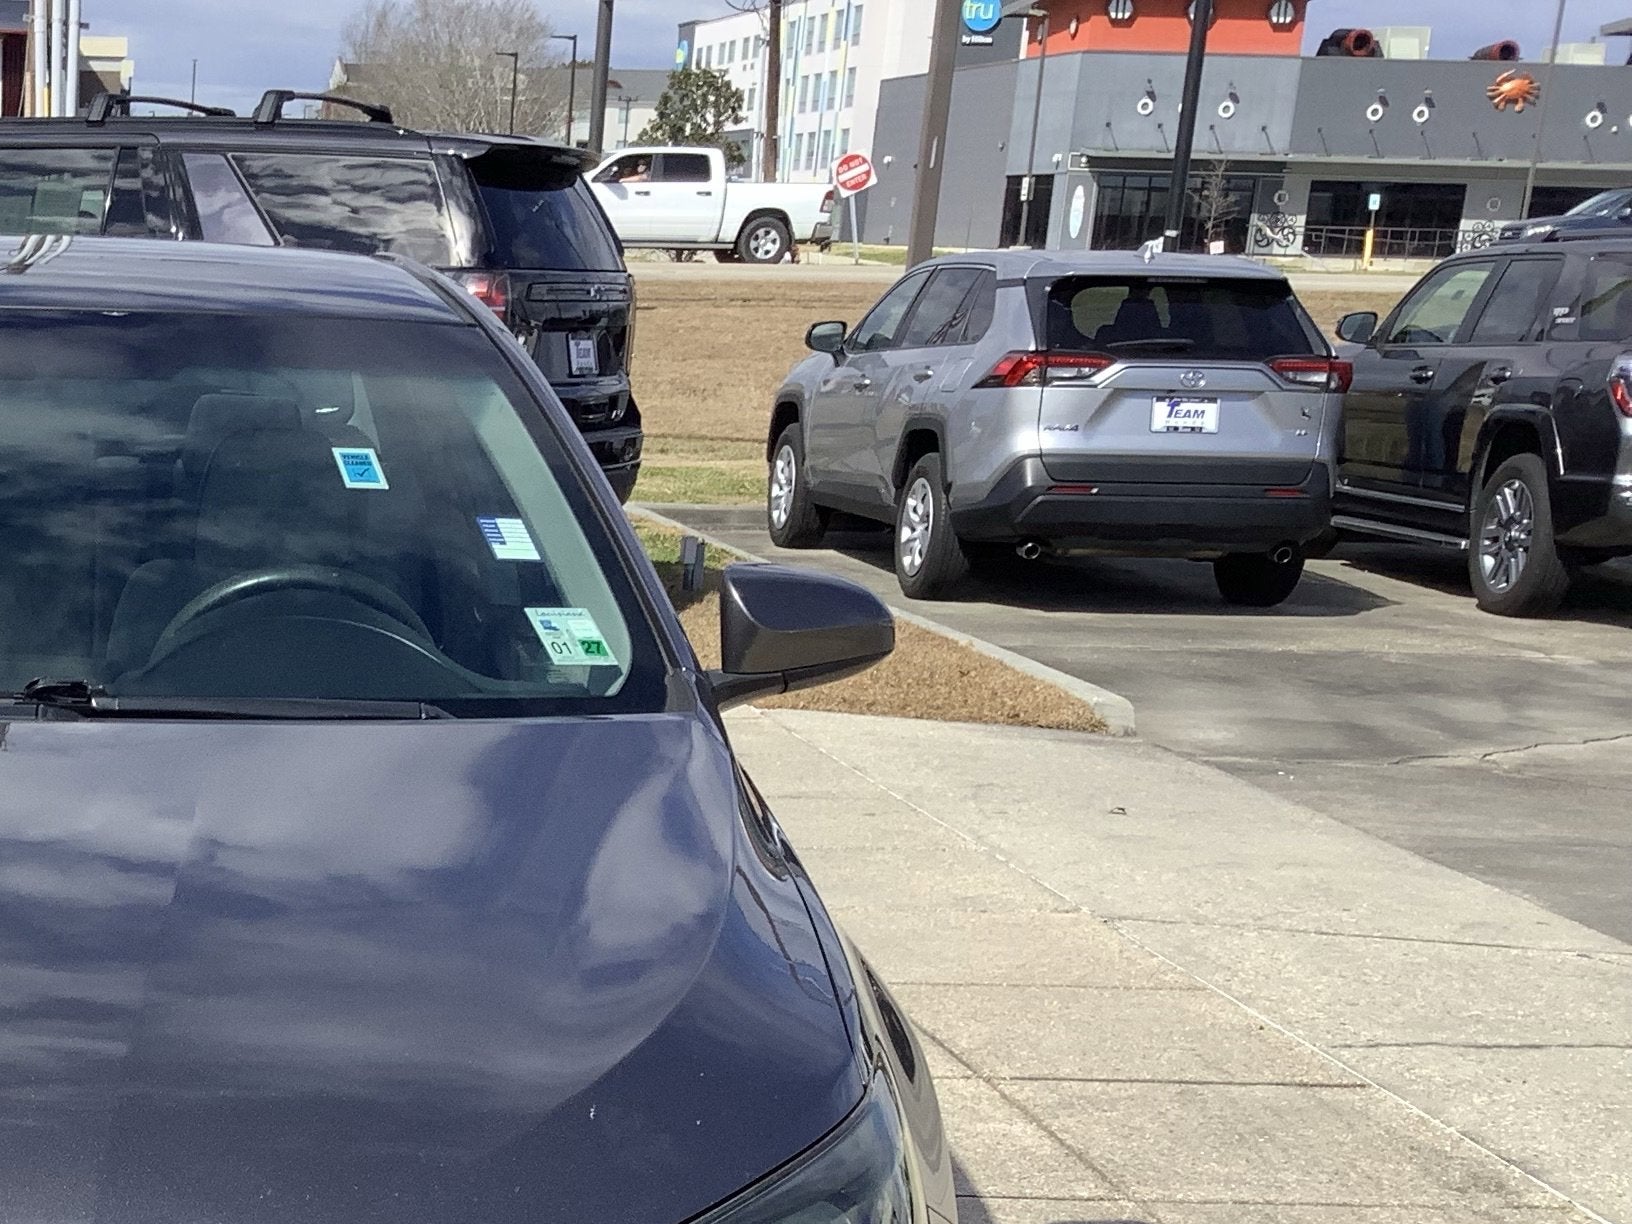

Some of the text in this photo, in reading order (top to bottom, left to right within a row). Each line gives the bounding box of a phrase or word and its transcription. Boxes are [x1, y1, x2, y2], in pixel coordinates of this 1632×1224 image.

[966, 0, 994, 20] tru
[1167, 400, 1206, 419] TEAM
[551, 640, 603, 655] 01 27
